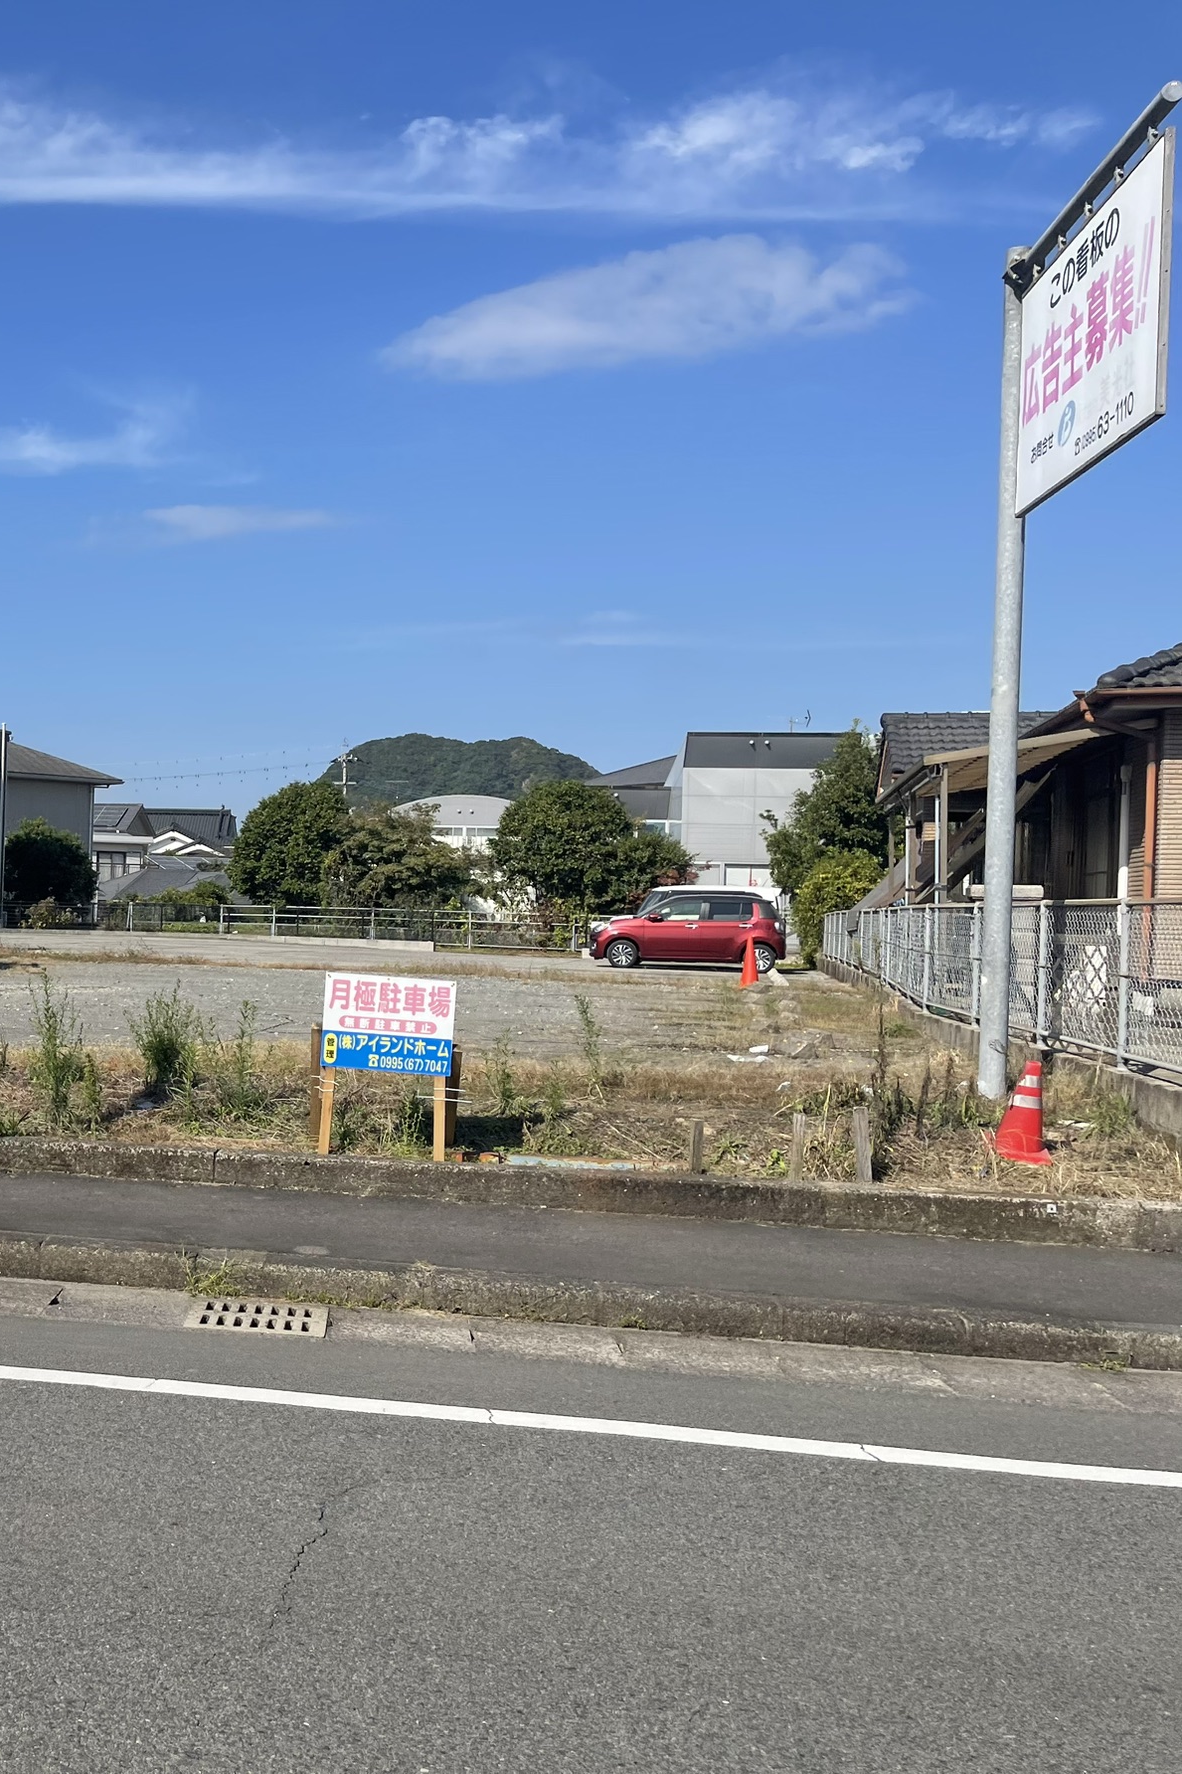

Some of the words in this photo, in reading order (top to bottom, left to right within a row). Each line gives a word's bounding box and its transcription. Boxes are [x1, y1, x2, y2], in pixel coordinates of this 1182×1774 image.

[1049, 207, 1120, 309] この看板の
[329, 979, 451, 1018] 月極駐車場
[345, 1018, 431, 1034] 無断駐車禁止
[326, 1038, 335, 1059] 管理
[381, 1056, 448, 1073] 0995(67)7047
